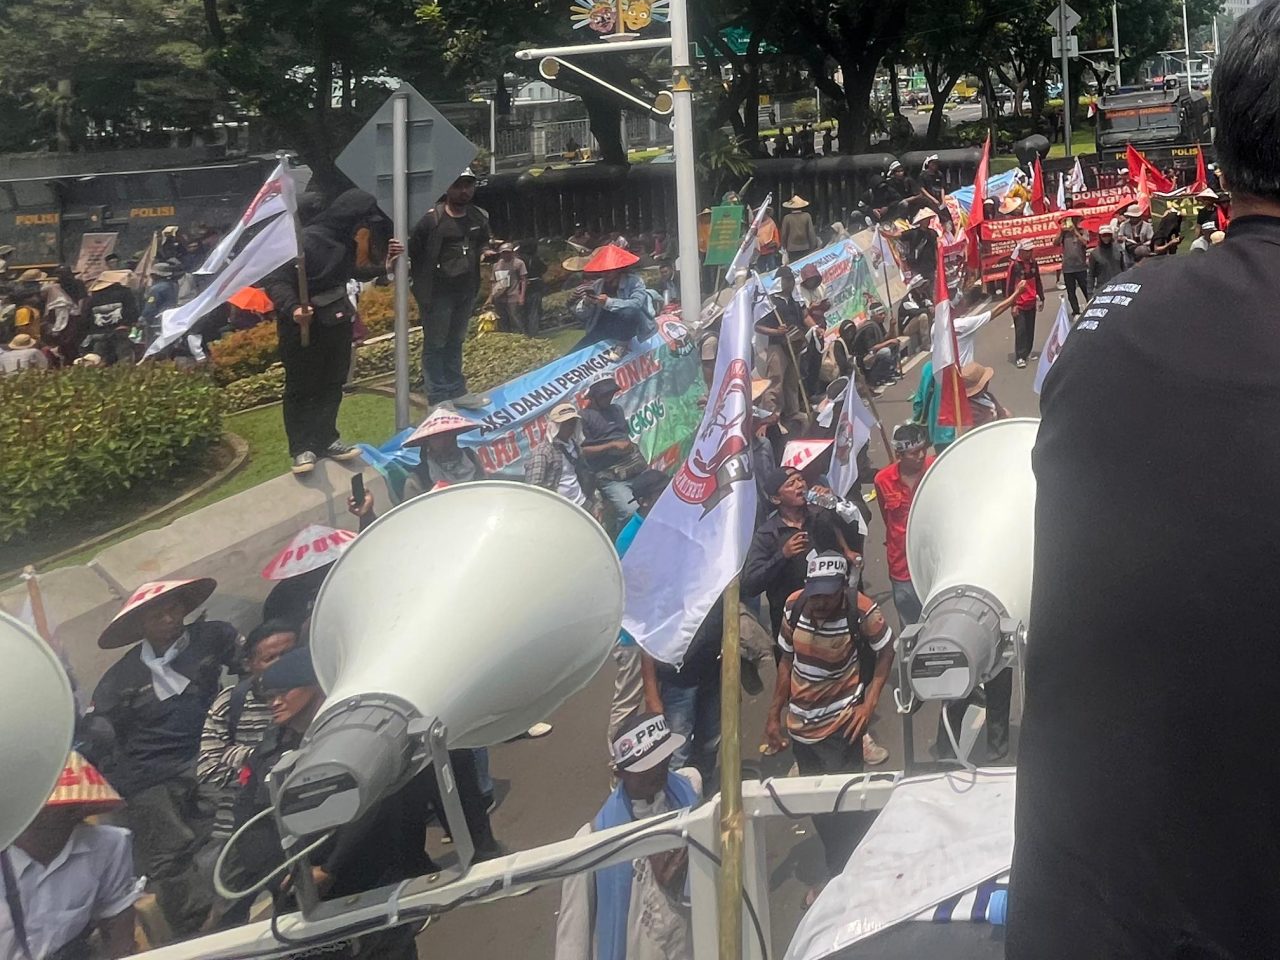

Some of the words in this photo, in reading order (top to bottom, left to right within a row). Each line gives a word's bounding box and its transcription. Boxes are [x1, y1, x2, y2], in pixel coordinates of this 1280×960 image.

[1171, 147, 1199, 157] POLIS
[15, 213, 60, 225] POLISI
[130, 206, 175, 218] POLISI
[991, 220, 1059, 239] AGRARIA
[480, 408, 518, 437] AKSI
[510, 381, 561, 420] DAMAI
[560, 346, 623, 392] PERINGAT
[477, 430, 522, 473] ARI
